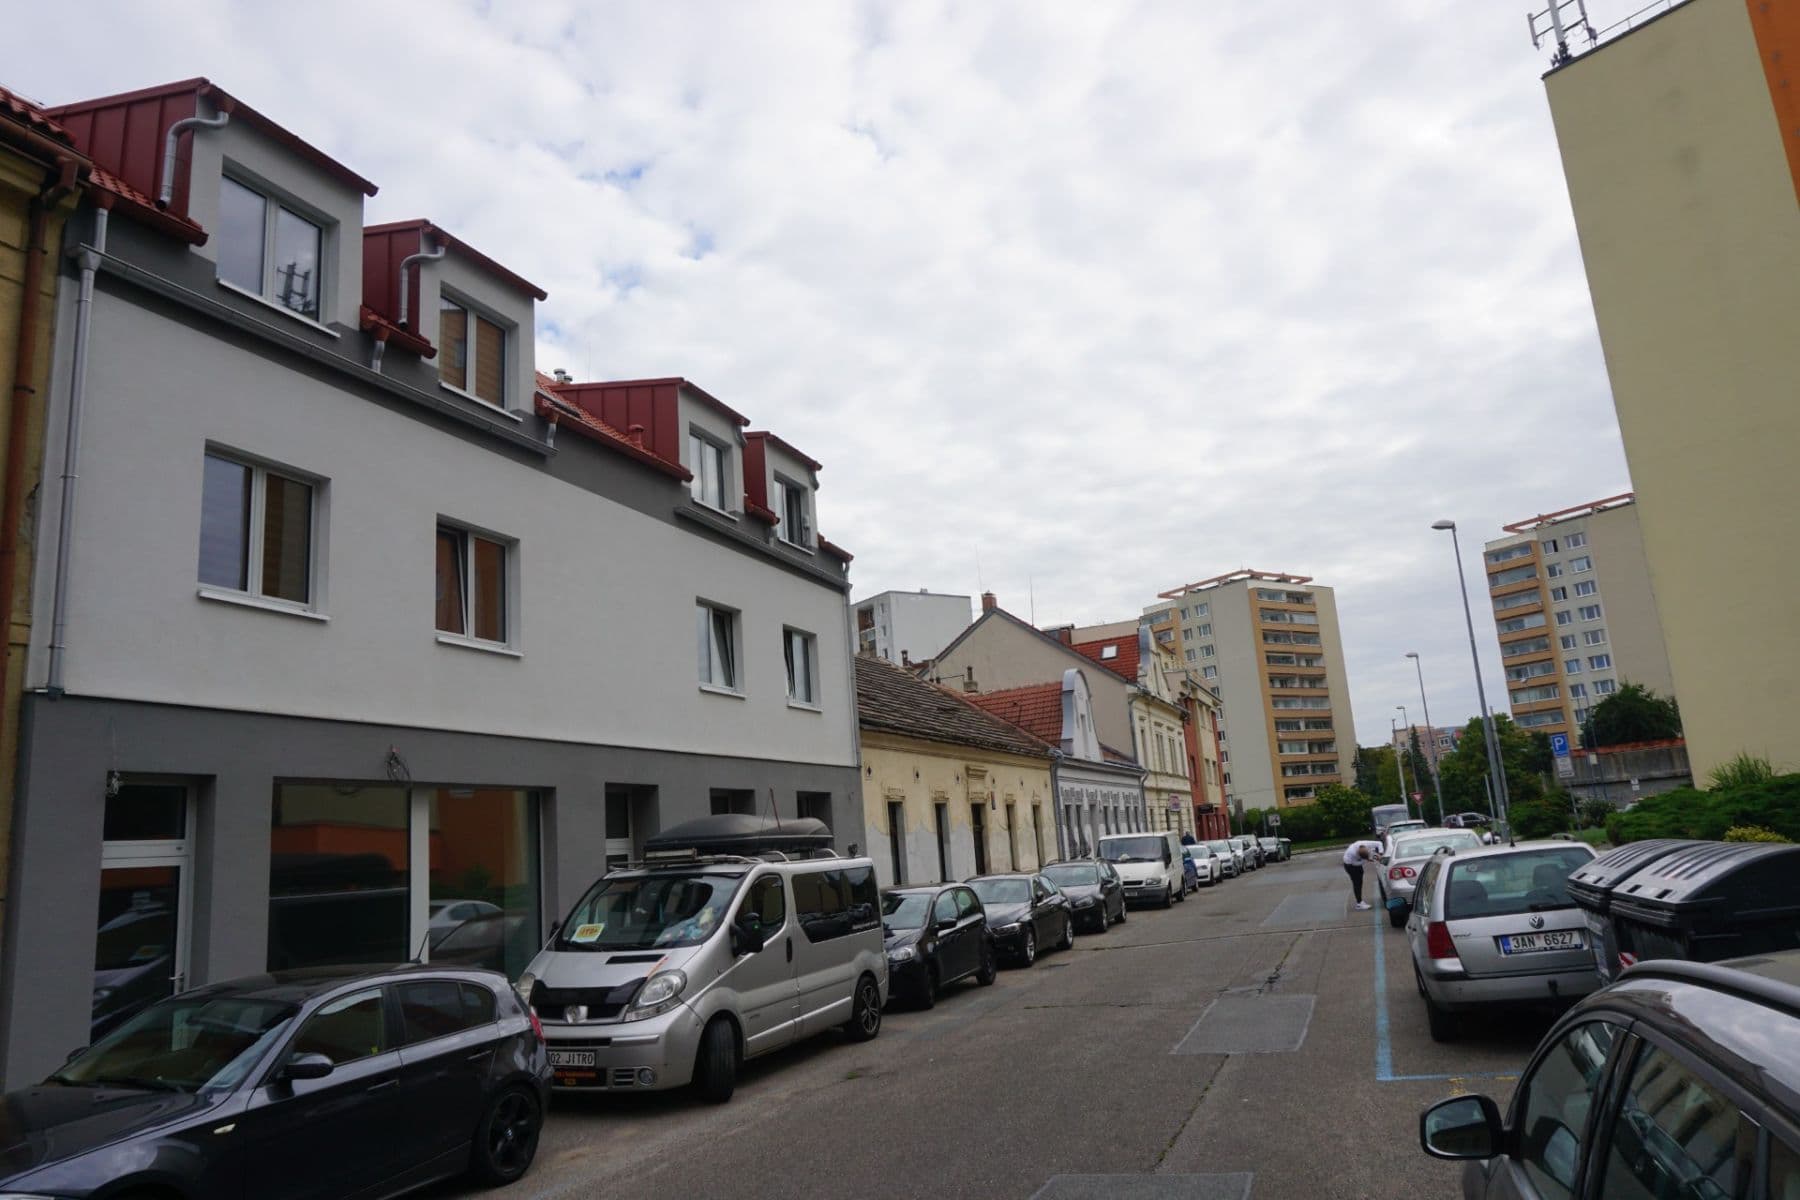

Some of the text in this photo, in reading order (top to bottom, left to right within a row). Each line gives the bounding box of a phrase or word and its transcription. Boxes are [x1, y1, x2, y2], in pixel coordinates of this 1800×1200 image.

[1554, 736, 1564, 751] P
[1512, 932, 1574, 949] 3AN 6627
